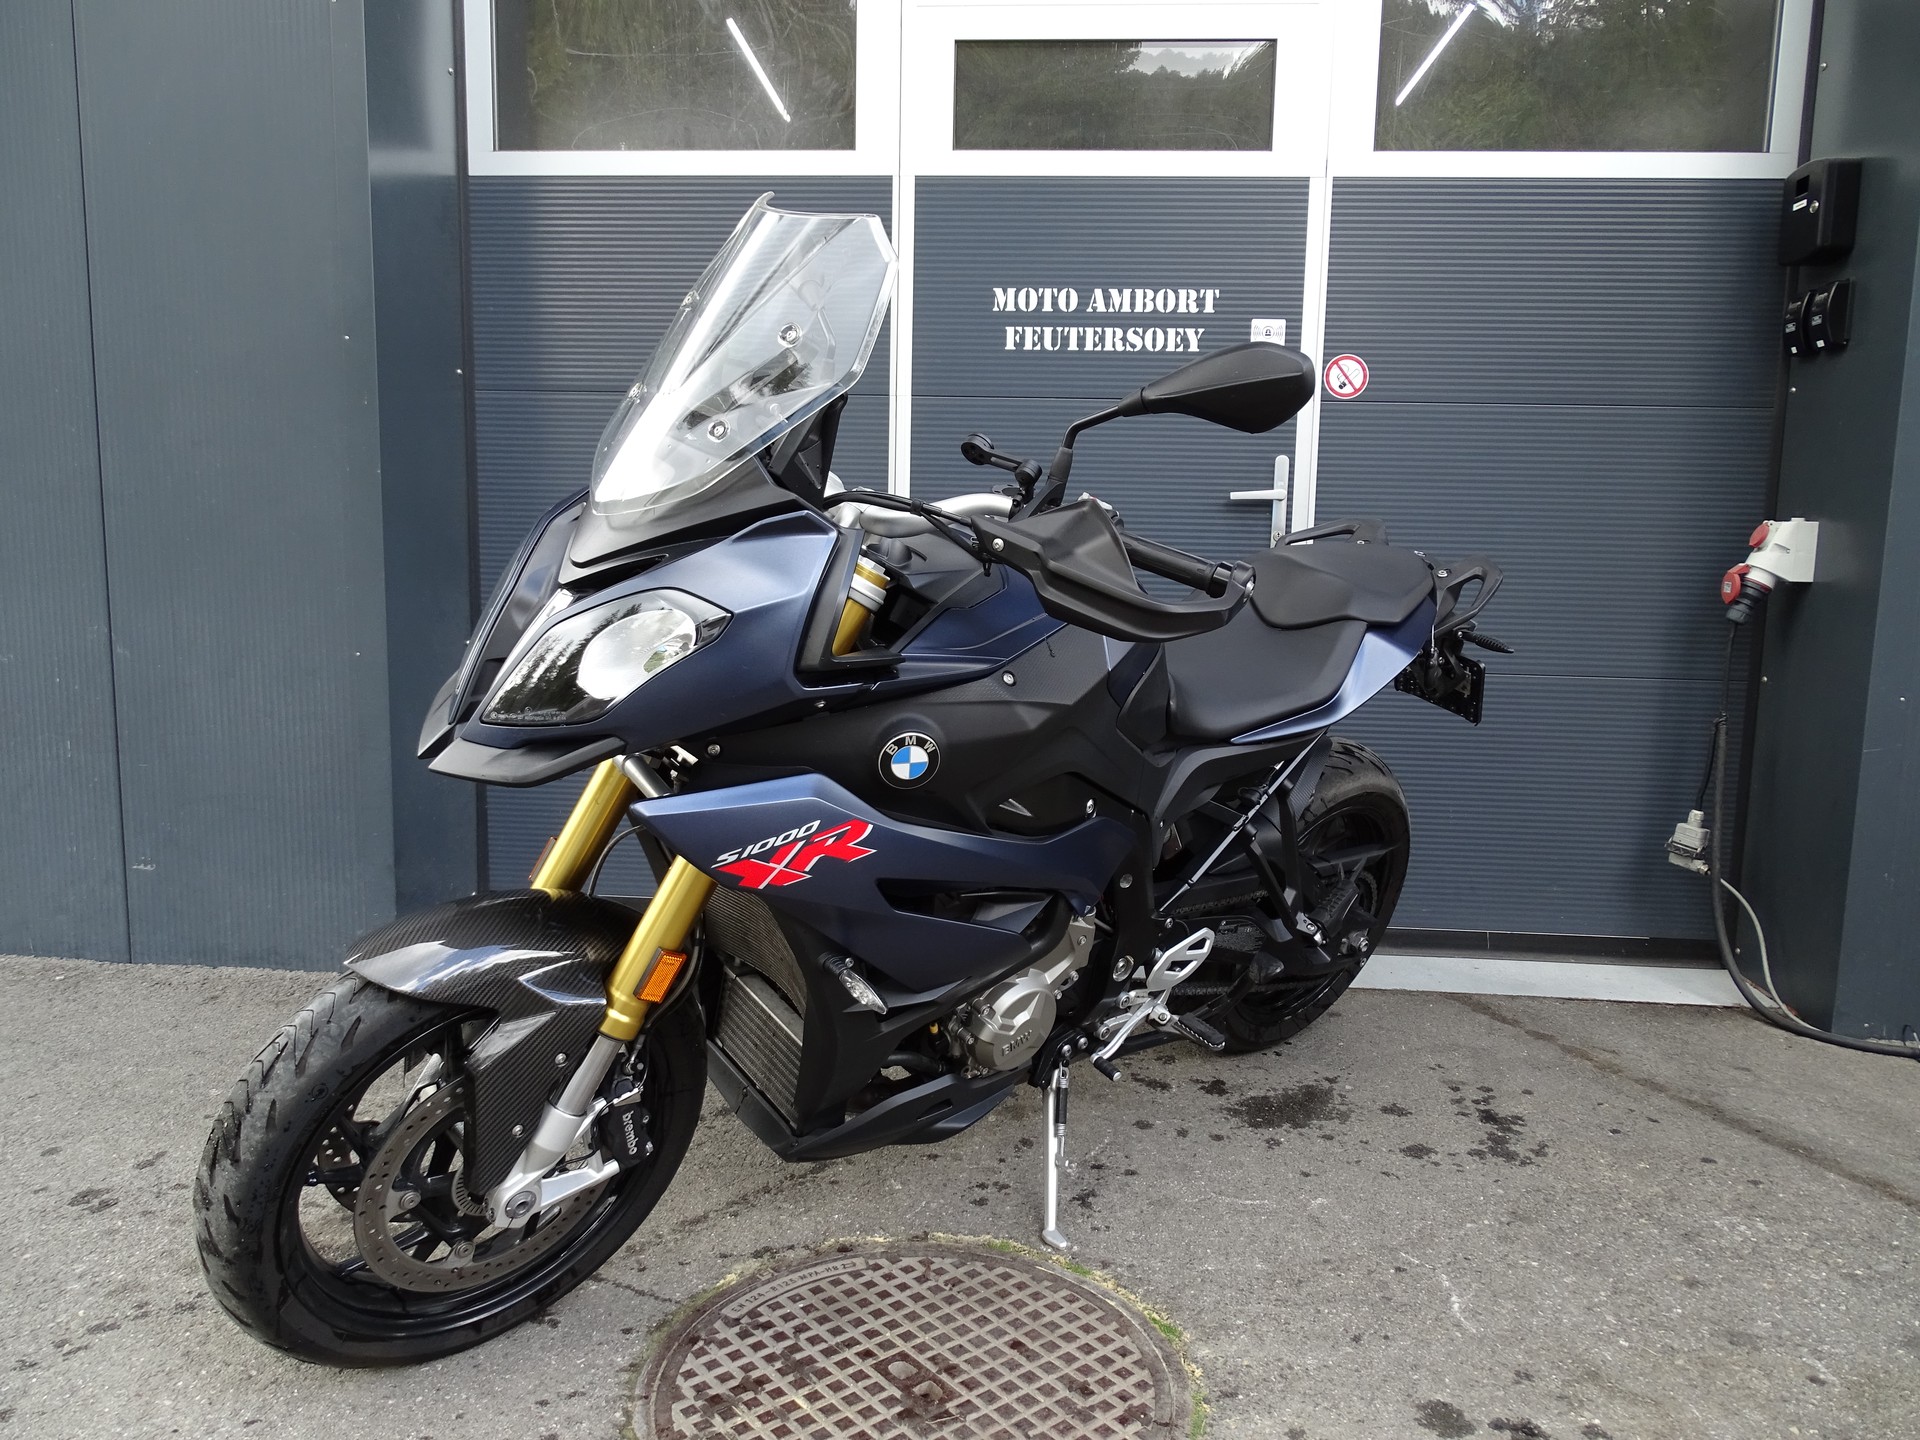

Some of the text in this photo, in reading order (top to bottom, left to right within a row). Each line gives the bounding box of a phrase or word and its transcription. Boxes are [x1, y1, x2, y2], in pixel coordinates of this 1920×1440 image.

[992, 287, 1220, 314] MOTO AMBORT
[1004, 326, 1206, 352] FEUTERSOEY
[885, 735, 936, 756] BMW
[711, 819, 821, 869] S1000
[715, 818, 878, 889] XR
[1001, 1029, 1033, 1058] BMW
[622, 1110, 640, 1155] brembo
